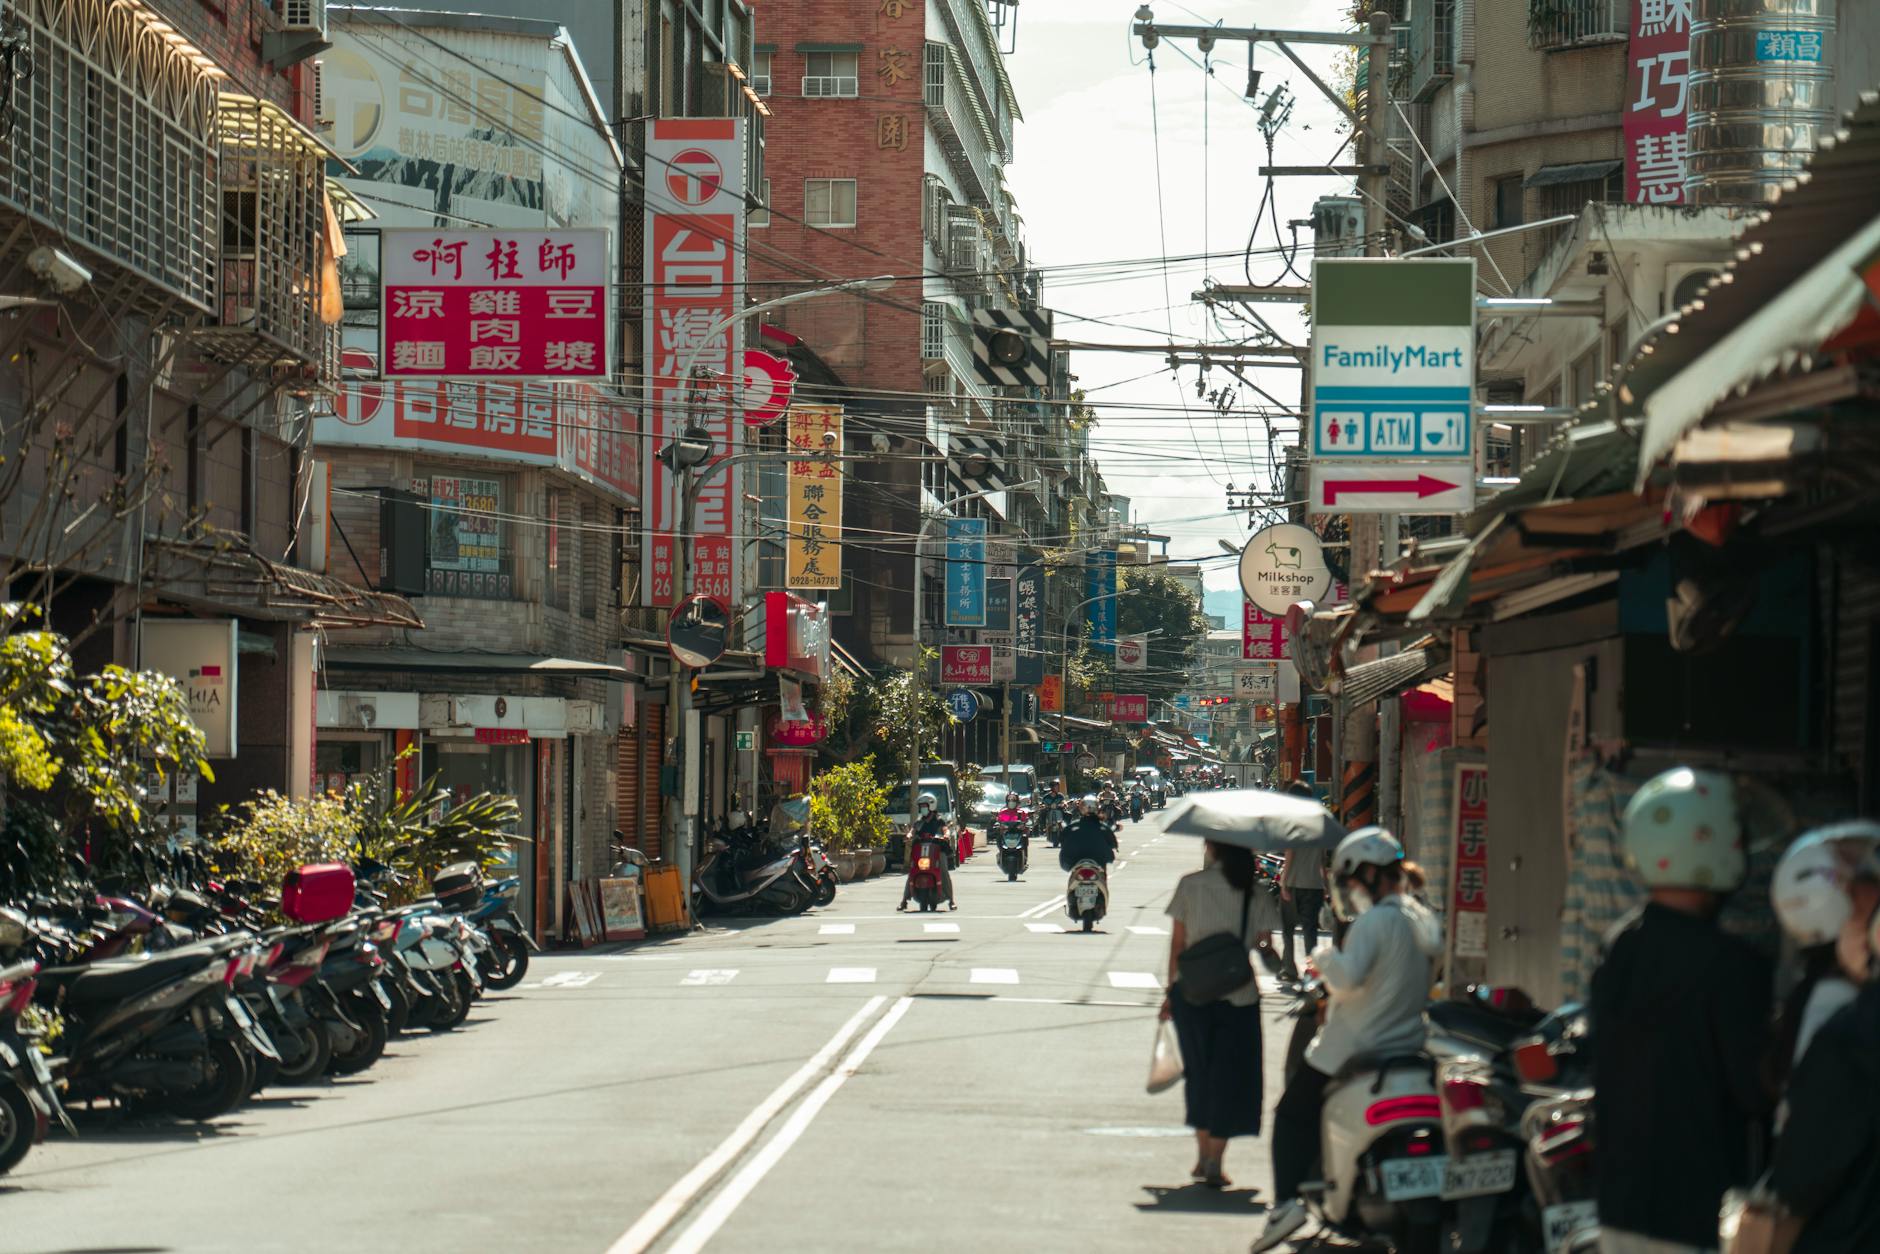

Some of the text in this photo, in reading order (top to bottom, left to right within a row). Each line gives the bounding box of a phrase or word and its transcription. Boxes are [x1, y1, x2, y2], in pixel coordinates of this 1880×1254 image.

[392, 290, 446, 370] 涼麵
[468, 289, 521, 371] 雞肉飯
[543, 289, 597, 371] 豆漿
[1323, 345, 1462, 373] FamilyMart
[1376, 418, 1411, 446] ATM
[802, 485, 827, 576] 聯合服務處
[655, 545, 729, 559] 樹后站
[655, 561, 729, 575] 特盟店
[1258, 571, 1314, 585] Milkshop
[655, 577, 729, 597] 265568
[790, 576, 838, 585] 0928-147781
[1119, 648, 1140, 659] SYM
